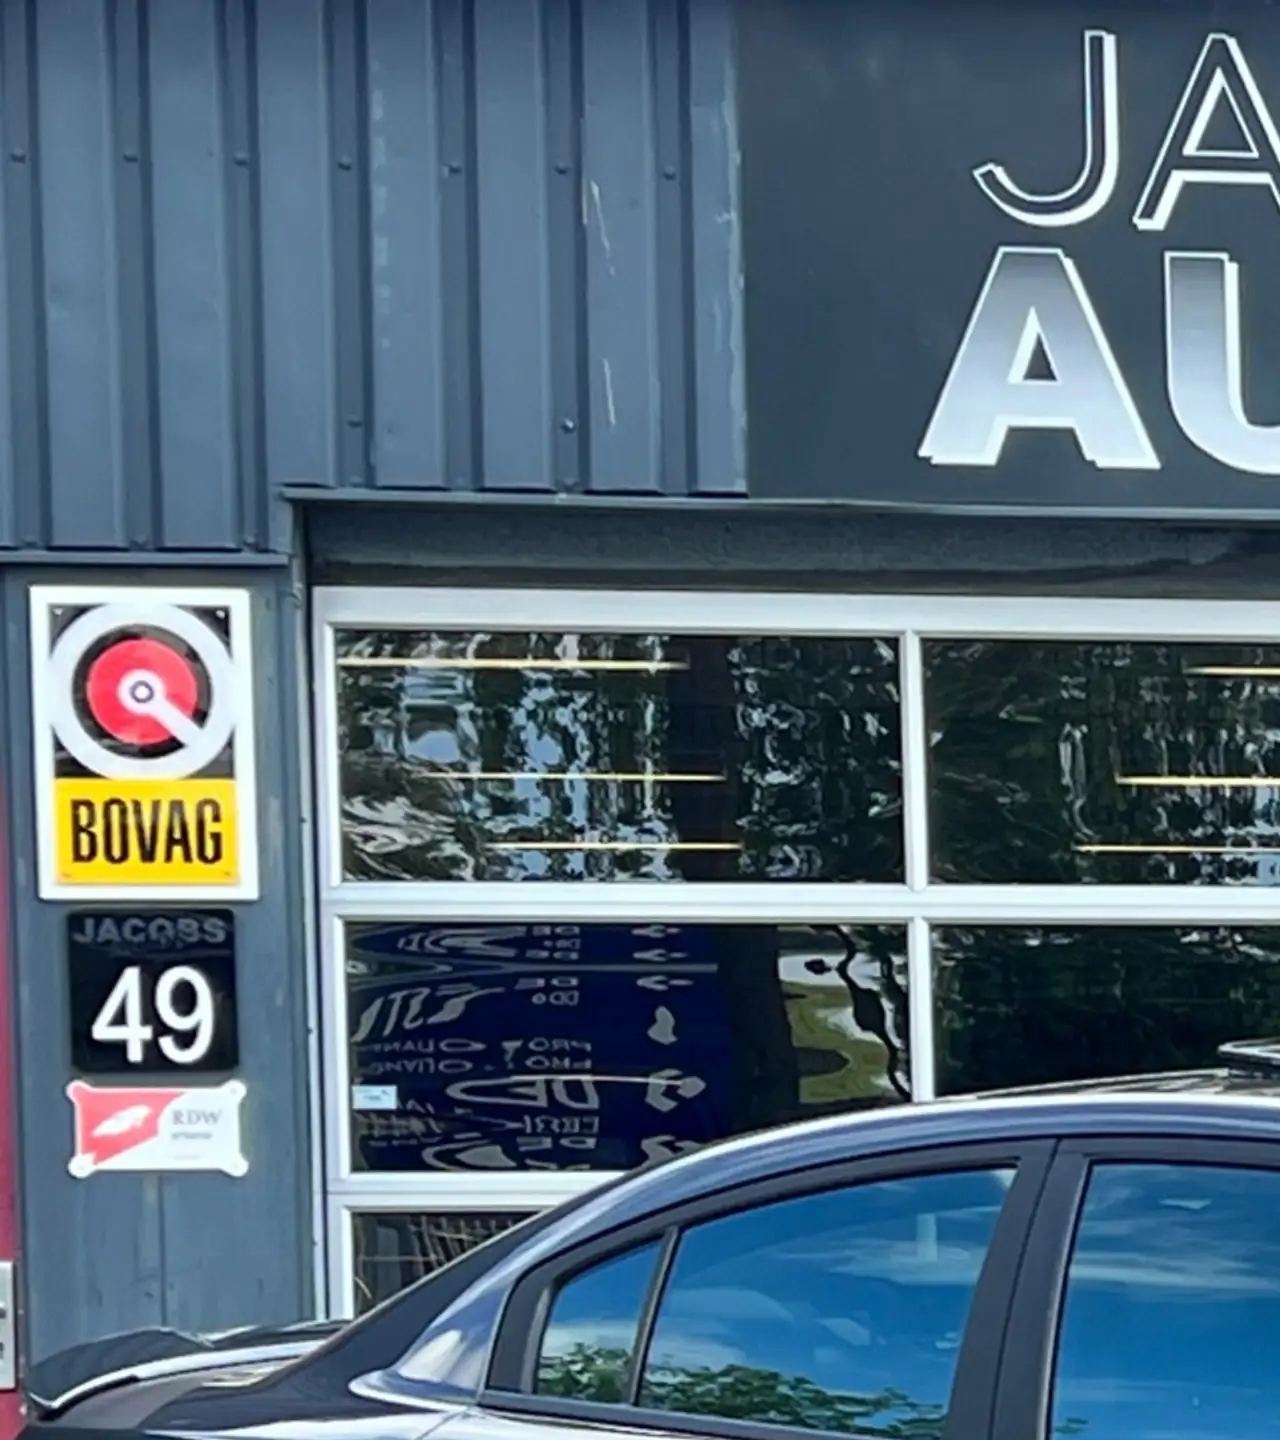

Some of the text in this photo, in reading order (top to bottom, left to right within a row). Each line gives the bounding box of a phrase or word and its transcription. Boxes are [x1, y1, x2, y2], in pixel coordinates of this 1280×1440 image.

[71, 797, 224, 864] BOVAG
[72, 917, 227, 943] JACOBS
[91, 964, 215, 1064] 49
[172, 1108, 223, 1126] RDW
